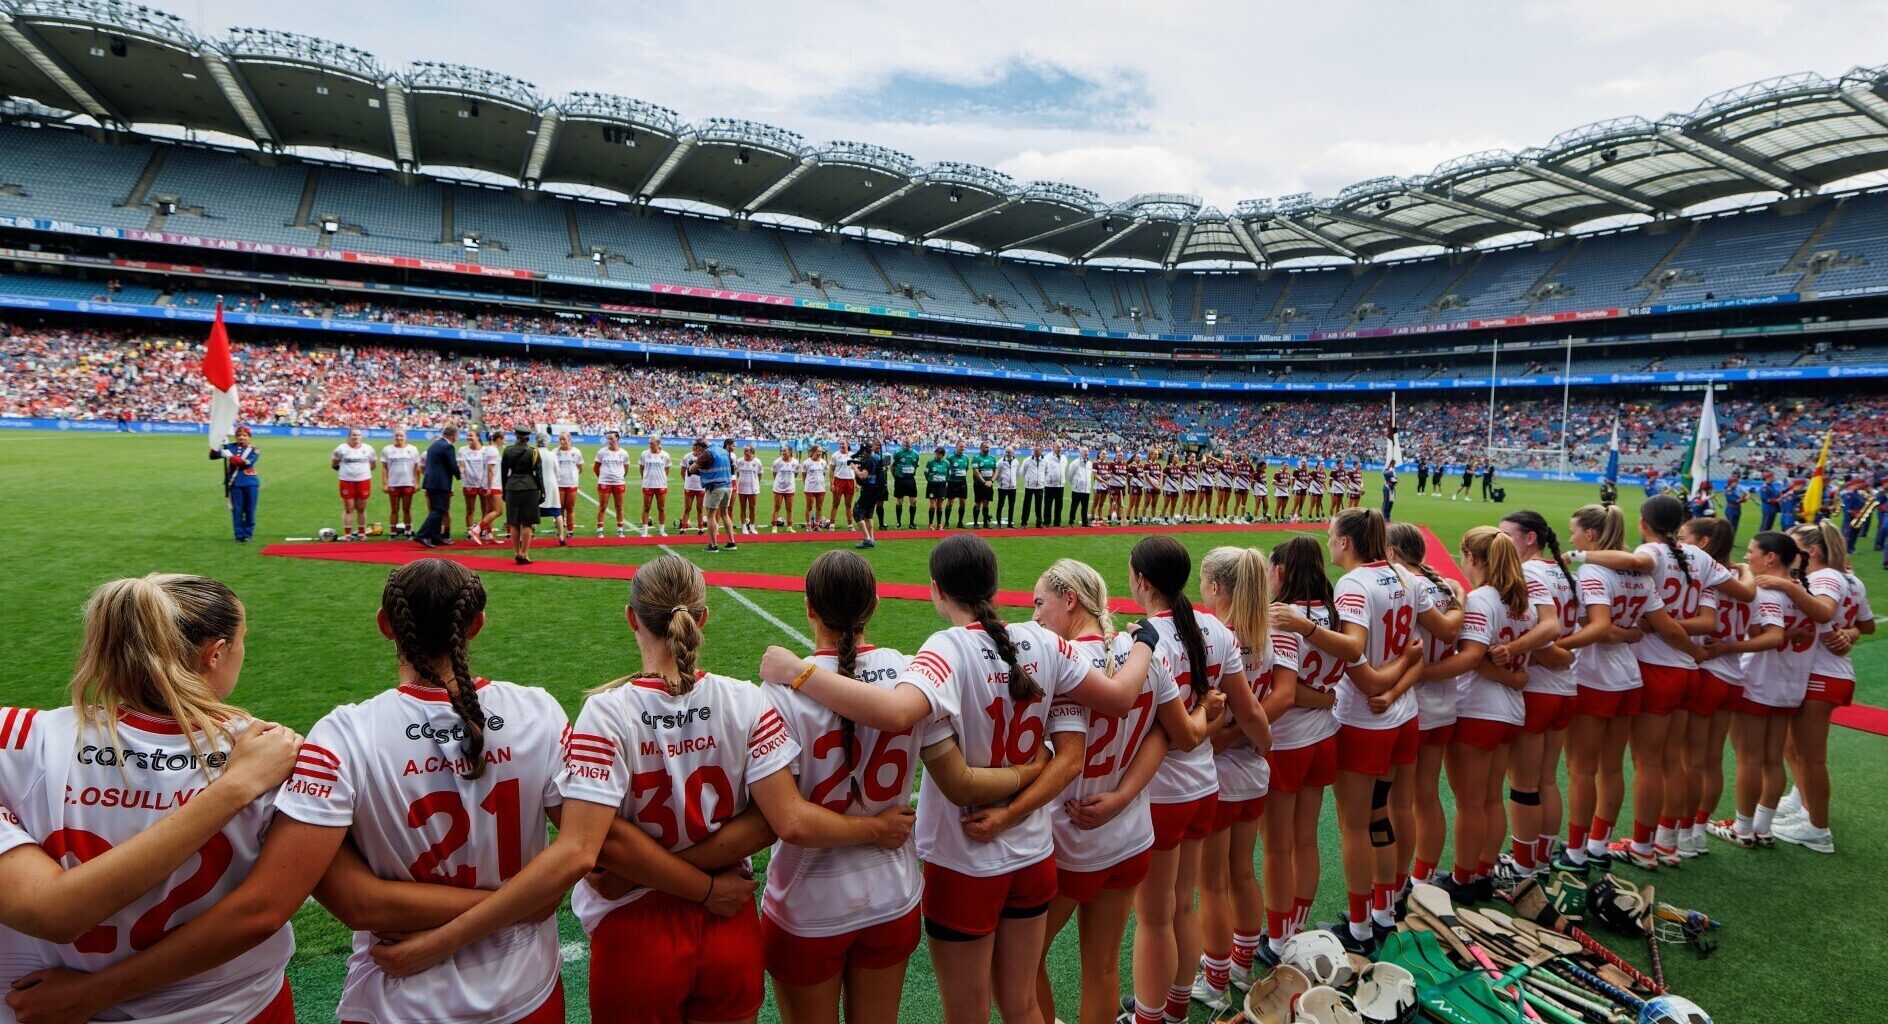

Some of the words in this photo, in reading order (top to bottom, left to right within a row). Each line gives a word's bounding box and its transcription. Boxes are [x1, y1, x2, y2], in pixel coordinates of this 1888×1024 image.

[1259, 333, 1281, 341] Allianz
[1383, 604, 1413, 661] 18
[77, 744, 227, 772] carstore
[985, 696, 1043, 769] 16
[810, 726, 912, 815] 26
[408, 778, 522, 888] 21
[632, 765, 735, 851] 30
